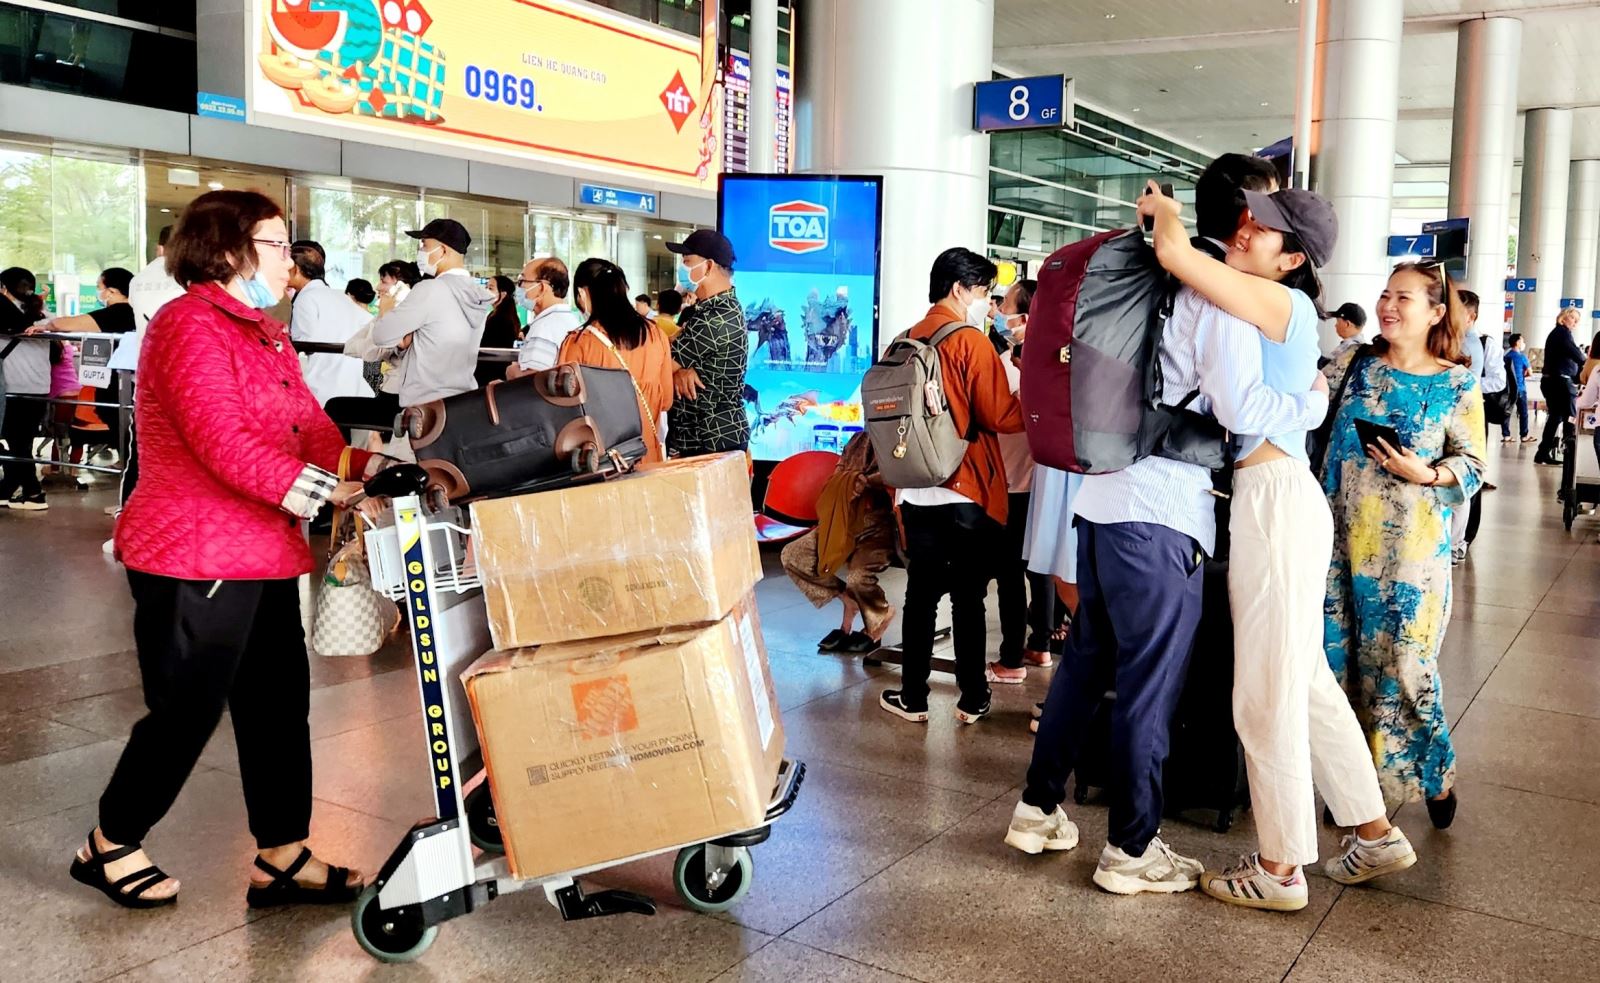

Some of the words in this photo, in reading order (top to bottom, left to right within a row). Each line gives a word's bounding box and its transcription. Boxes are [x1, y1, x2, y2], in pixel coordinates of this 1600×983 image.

[465, 65, 543, 112] 0969.
[1008, 85, 1030, 121] 8
[1041, 107, 1057, 119] GF
[639, 195, 654, 211] A1
[773, 216, 824, 238] TOA
[1405, 237, 1418, 254] 7
[1517, 279, 1526, 291] 6
[83, 370, 105, 380] GUPTA
[408, 561, 437, 683] GOLDSUN
[427, 704, 451, 790] GROUP
[630, 739, 705, 764] HDMOVING.COM
[632, 739, 658, 752] YOUR
